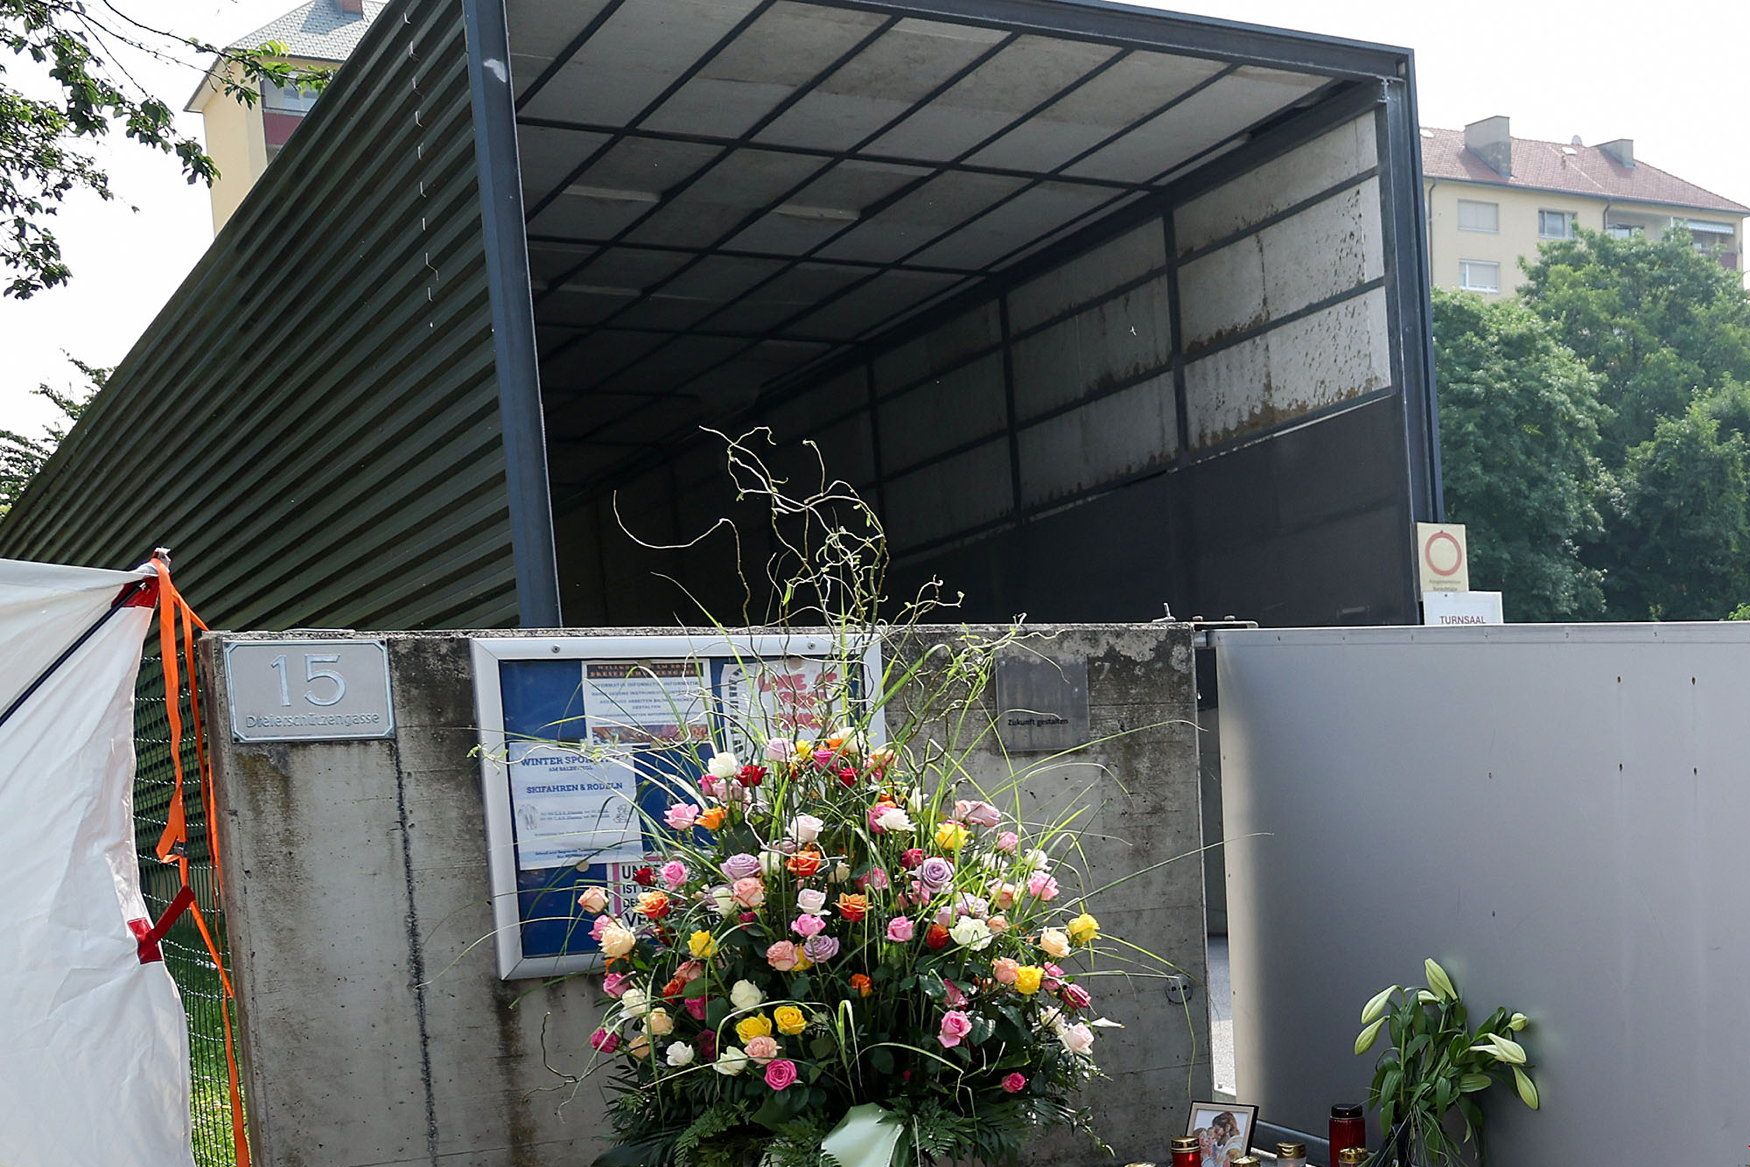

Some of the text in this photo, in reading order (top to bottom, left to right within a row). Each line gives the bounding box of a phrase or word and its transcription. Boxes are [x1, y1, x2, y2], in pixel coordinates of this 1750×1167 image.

[1440, 616, 1486, 625] TURNSAAL
[271, 653, 346, 706] 15
[521, 757, 563, 767] WINTER
[526, 784, 578, 794] SKIFAHREN
